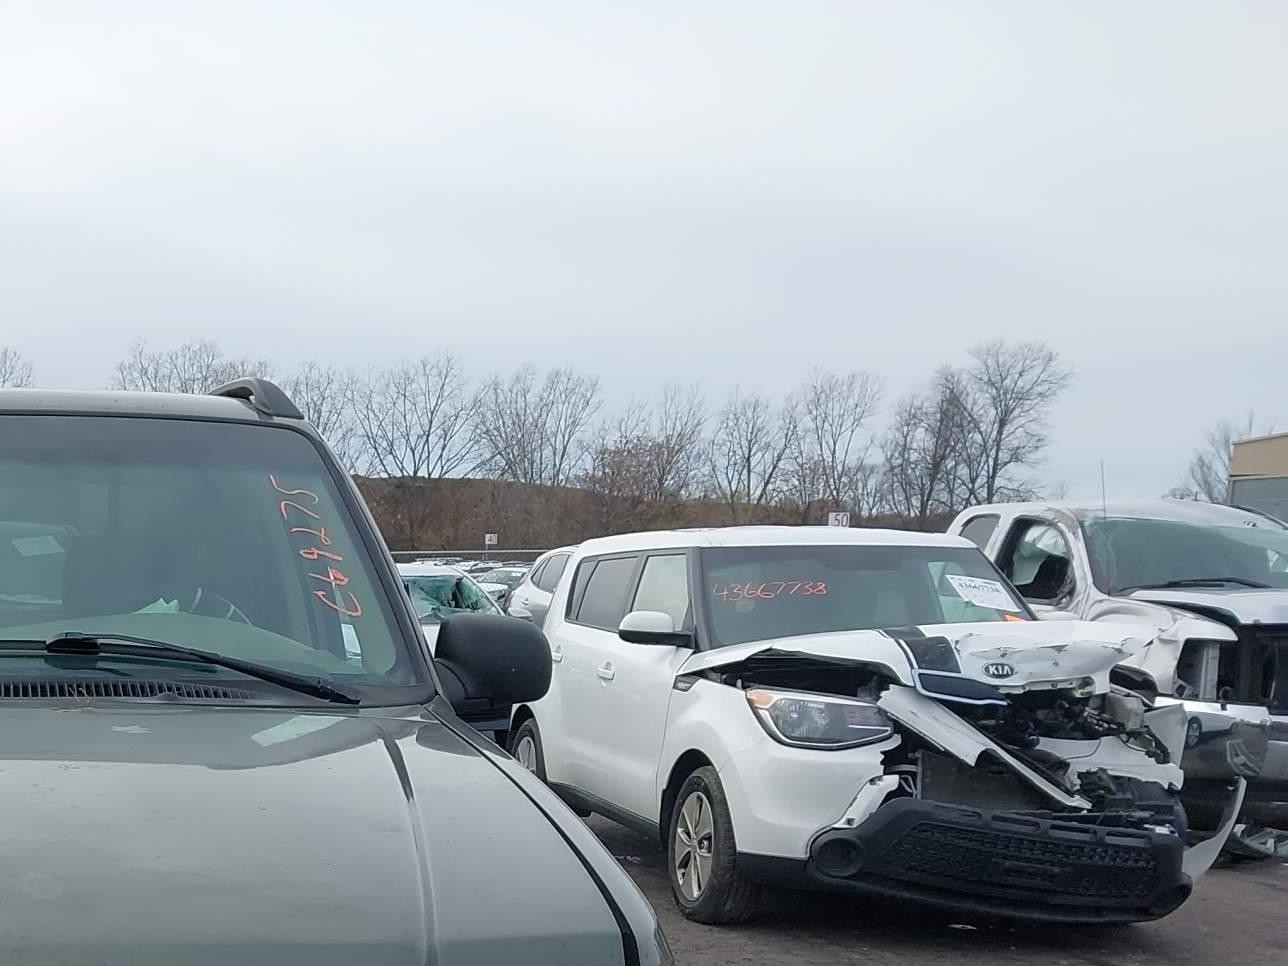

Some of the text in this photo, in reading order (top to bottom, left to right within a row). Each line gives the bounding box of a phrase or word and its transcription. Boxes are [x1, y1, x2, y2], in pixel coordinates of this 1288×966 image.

[834, 513, 849, 527] 50
[713, 582, 827, 601] 43667738
[988, 665, 1012, 675] KIA
